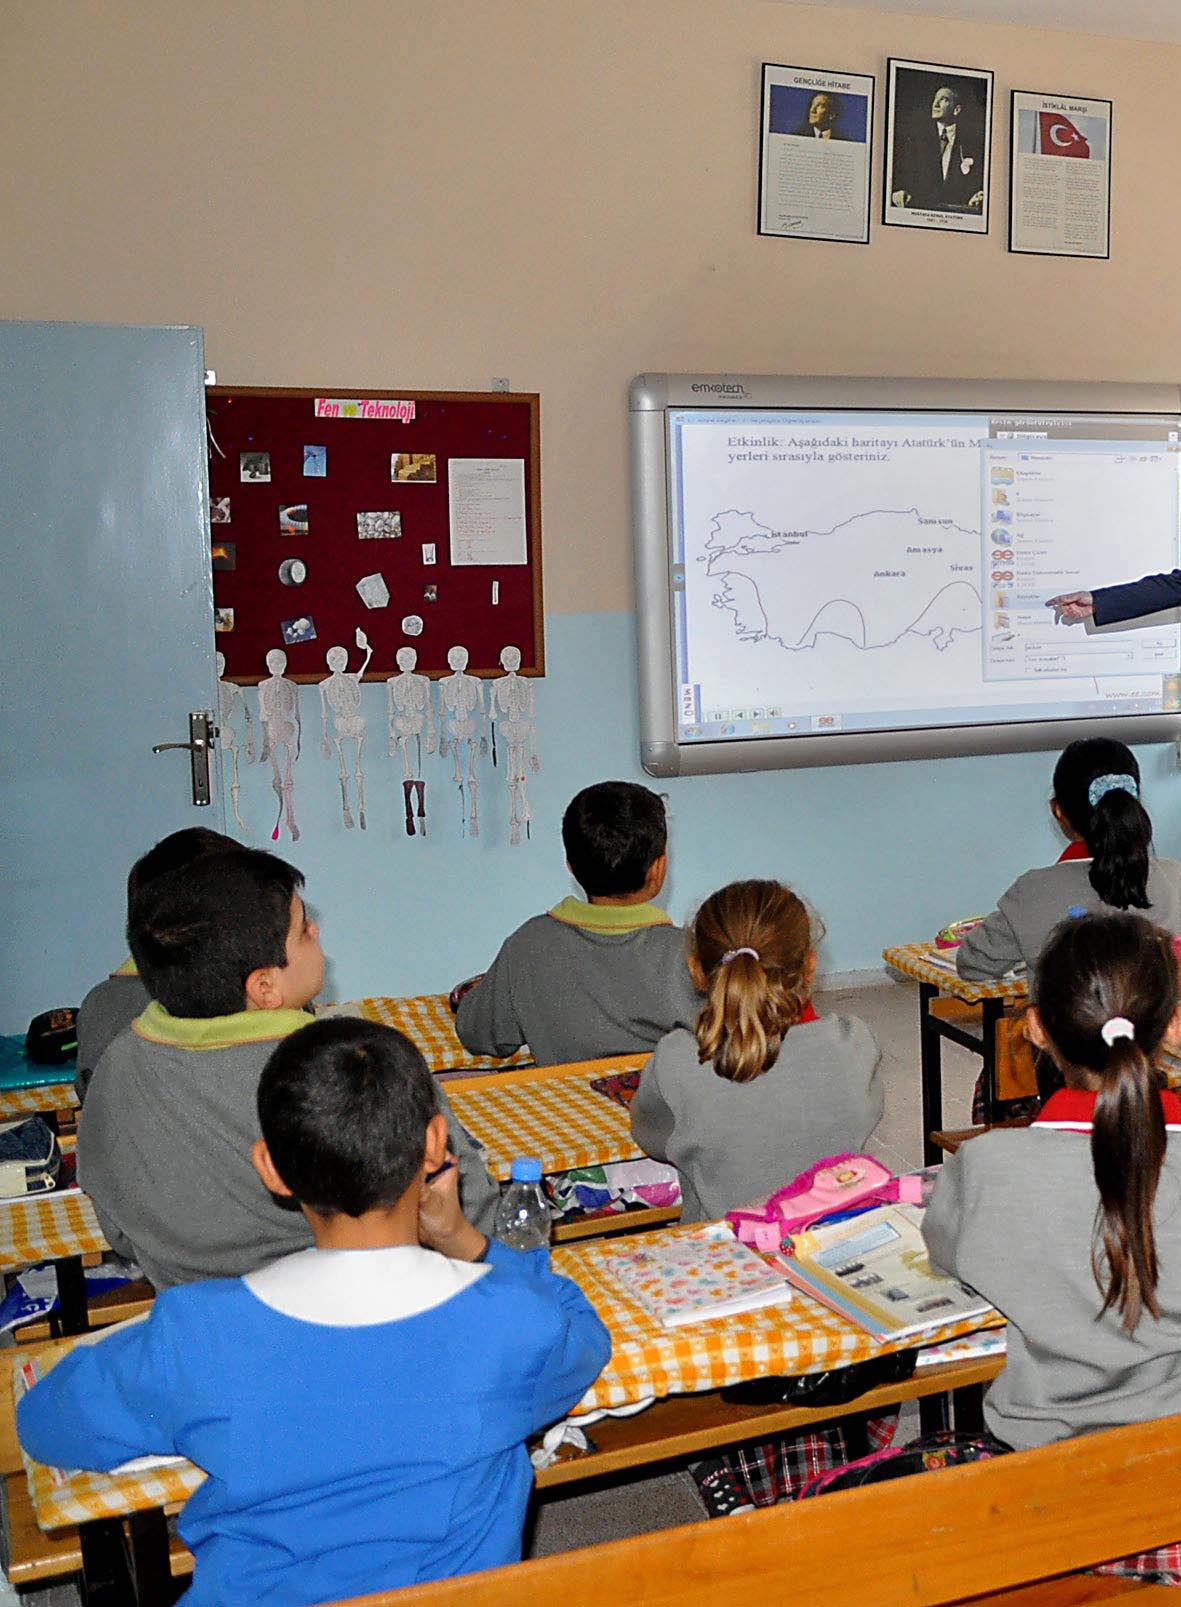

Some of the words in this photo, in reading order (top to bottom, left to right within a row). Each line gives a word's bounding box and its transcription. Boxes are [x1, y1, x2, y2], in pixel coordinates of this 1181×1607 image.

[828, 80, 851, 89] HİTABE
[317, 399, 340, 417] Fen
[343, 403, 357, 417] ve
[361, 400, 415, 423] Teknoloji
[727, 436, 783, 447] Etkinlik:
[787, 437, 848, 449] Aşağıdaki
[851, 438, 898, 449] haritayı
[728, 451, 768, 463] yerleri
[772, 451, 824, 463] sırasıyla
[828, 451, 891, 463] gösteriniz.
